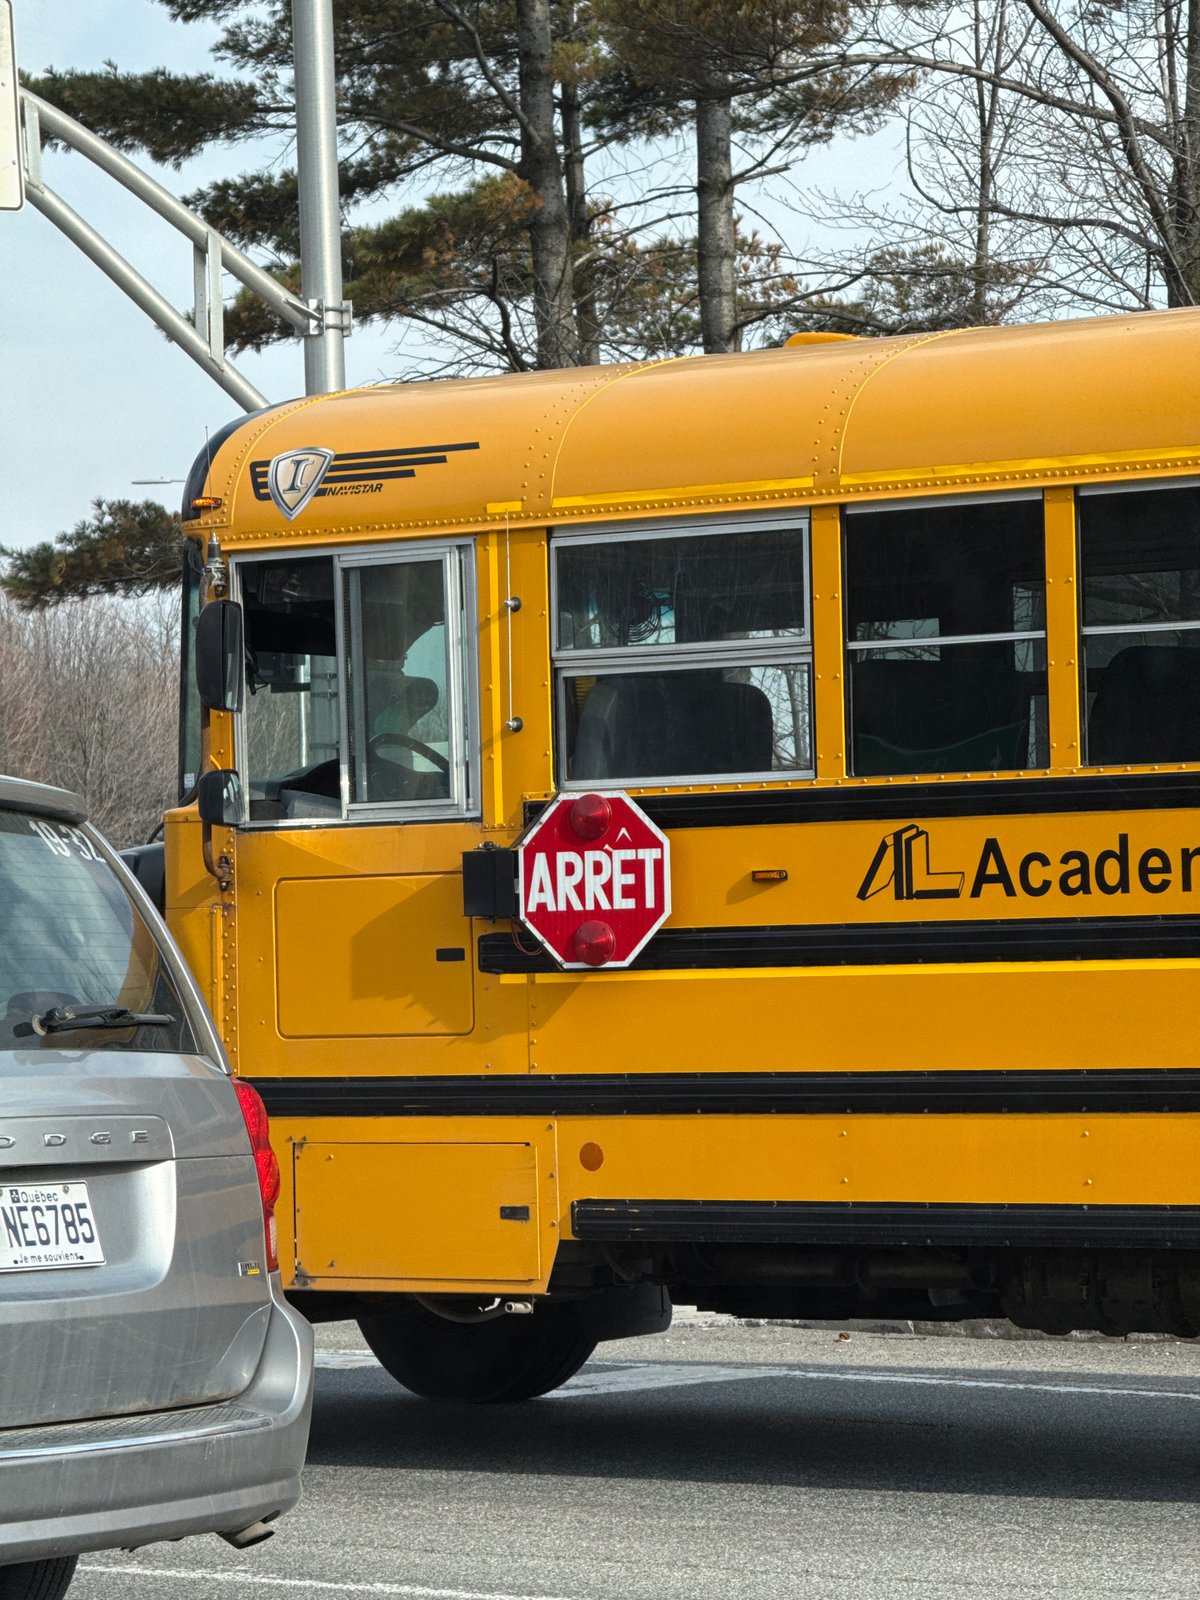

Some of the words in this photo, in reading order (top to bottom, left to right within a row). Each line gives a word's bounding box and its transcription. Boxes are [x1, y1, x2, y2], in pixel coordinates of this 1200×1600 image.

[327, 483, 383, 496] NAVISTAR
[28, 820, 107, 863] 19-32
[527, 827, 662, 912] ARRÊT
[20, 1190, 59, 1203] Québec
[1, 1203, 95, 1248] NE6785
[19, 1253, 29, 1264] Je
[30, 1254, 43, 1262] me
[44, 1250, 80, 1262] souviens
